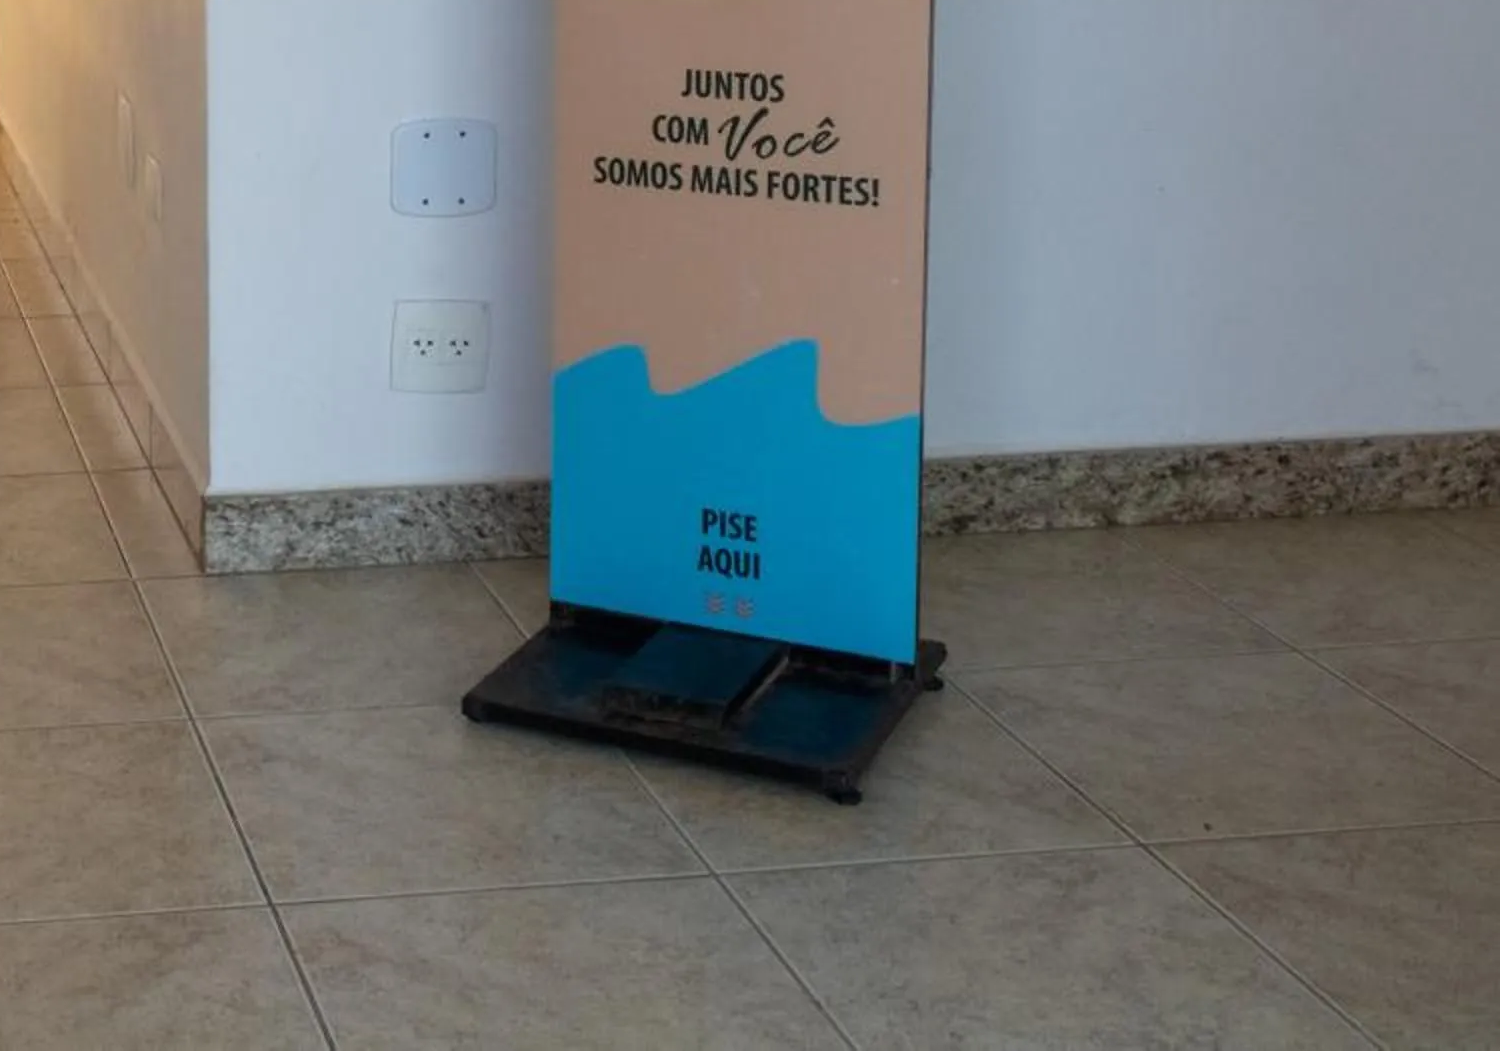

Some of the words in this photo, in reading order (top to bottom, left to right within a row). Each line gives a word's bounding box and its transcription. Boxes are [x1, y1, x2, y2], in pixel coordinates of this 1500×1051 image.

[681, 68, 785, 103] JUNTOS
[652, 114, 709, 146] COM
[717, 106, 840, 161] Você
[593, 156, 684, 192] SOMOS
[690, 165, 758, 198] MAIS
[766, 171, 880, 207] FORTES!
[702, 508, 757, 544] PISE
[697, 545, 761, 580] AQUI
